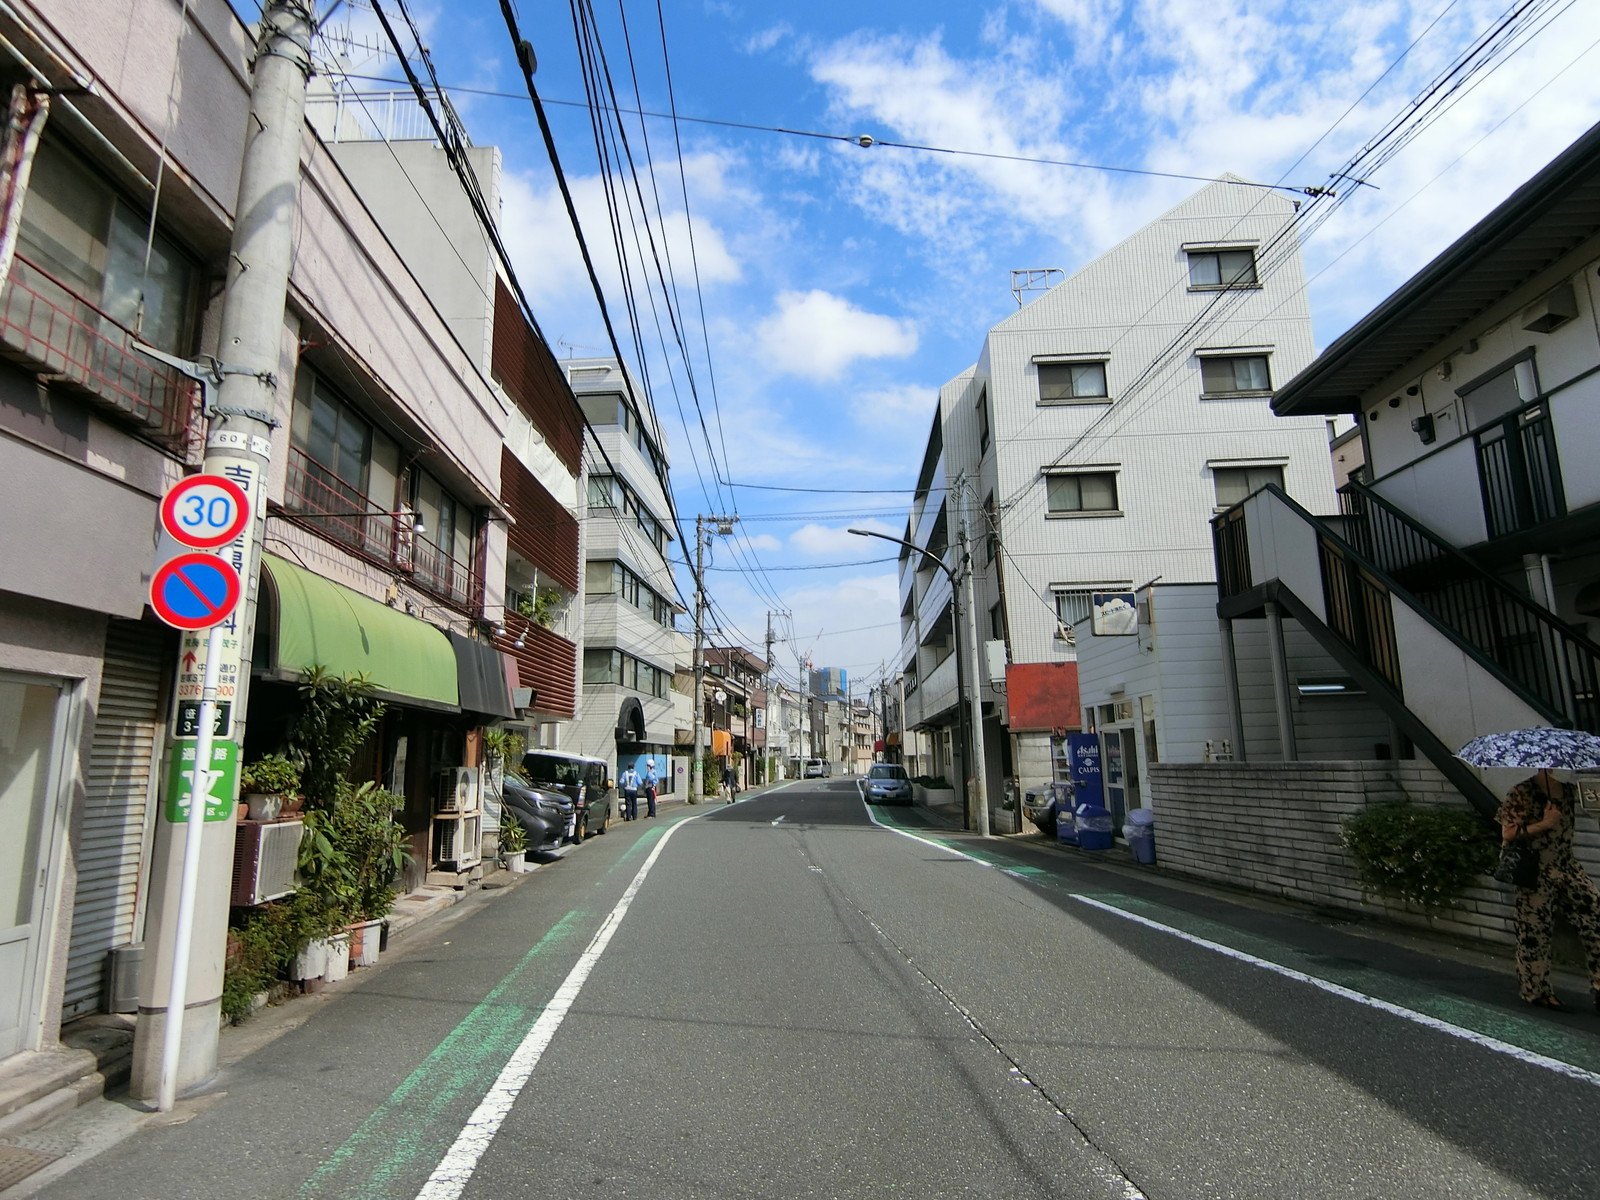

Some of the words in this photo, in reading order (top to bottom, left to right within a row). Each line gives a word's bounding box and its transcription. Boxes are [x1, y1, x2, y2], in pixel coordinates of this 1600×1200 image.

[182, 495, 231, 528] 30
[181, 747, 228, 761] 通路
[1076, 745, 1099, 755] Asahi
[1078, 766, 1100, 775] CALPIS
